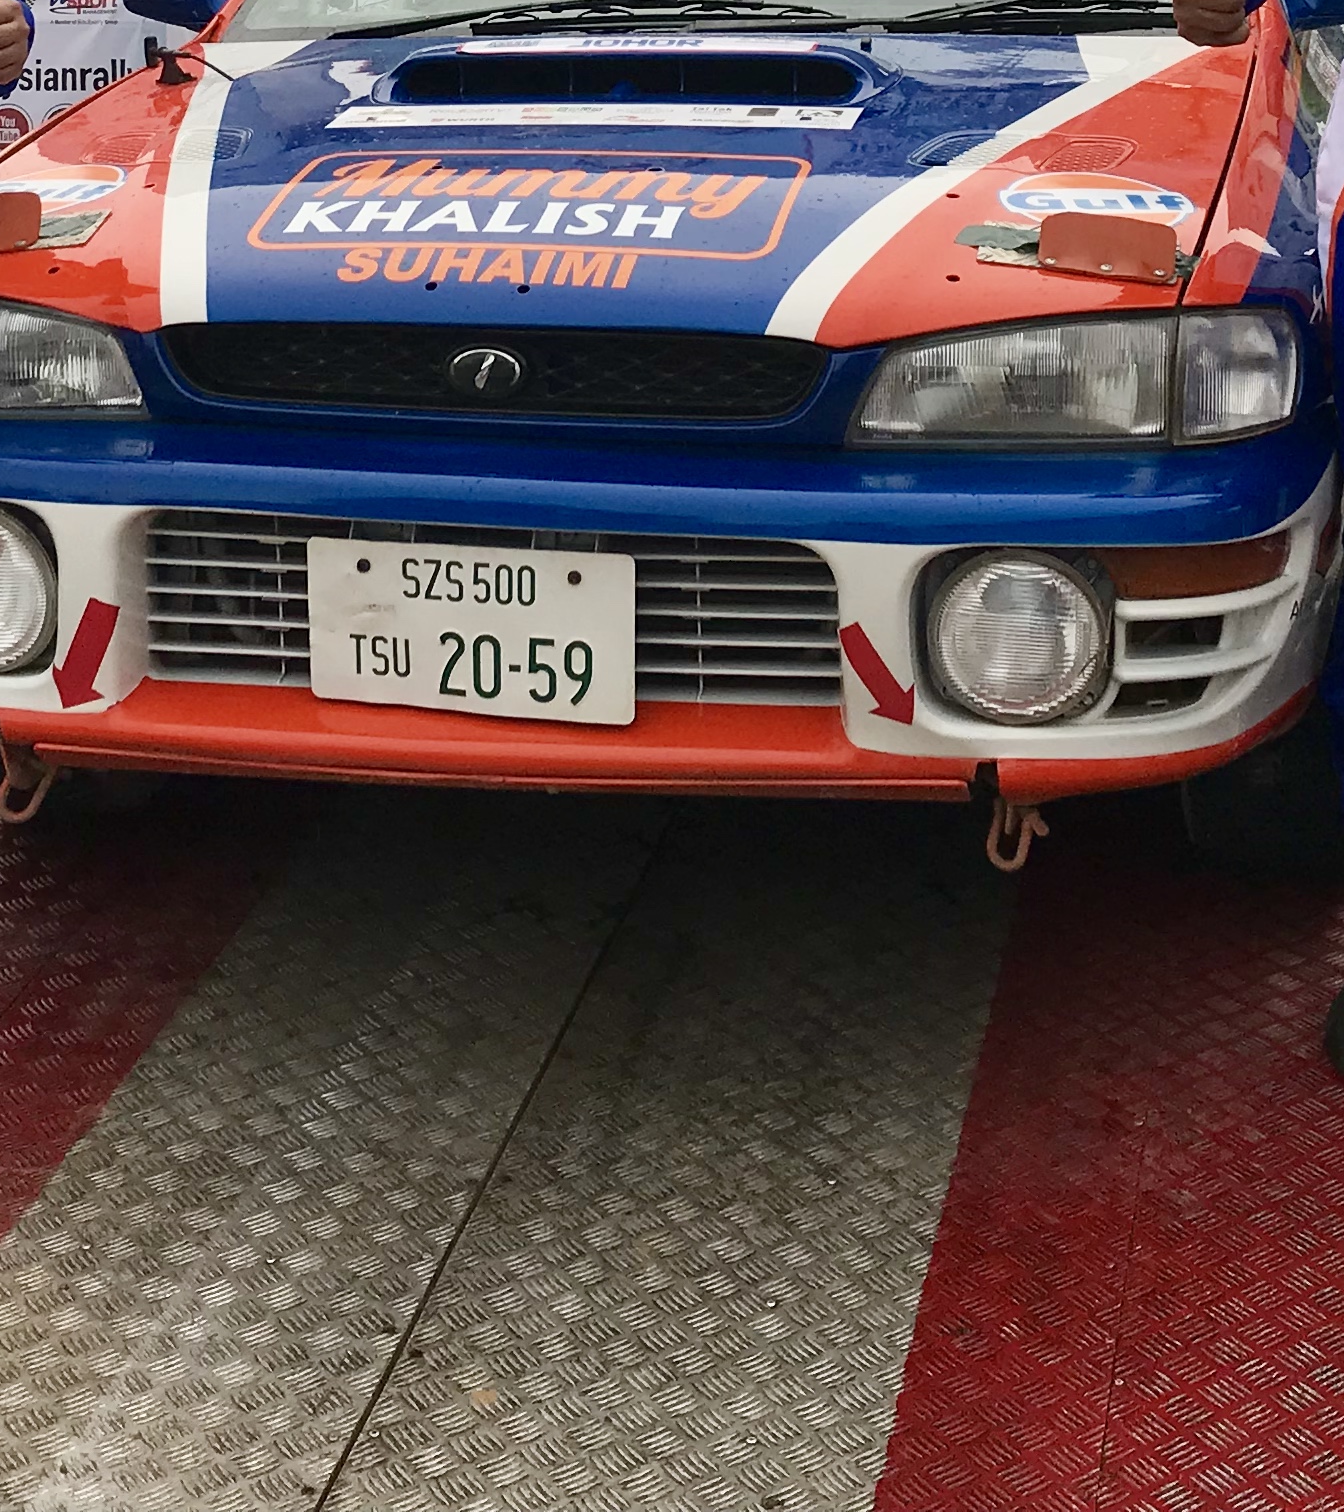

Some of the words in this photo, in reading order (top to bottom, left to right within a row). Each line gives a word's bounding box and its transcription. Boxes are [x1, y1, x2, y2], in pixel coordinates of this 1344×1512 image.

[569, 39, 704, 48] JOHOR
[0, 116, 15, 127] You
[314, 159, 766, 219] Mummy
[1006, 192, 1185, 210] Gulf
[283, 200, 684, 239] KHALISH
[337, 248, 638, 289] SUHAIMI
[401, 558, 464, 602] SZS
[473, 563, 536, 606] 500
[350, 634, 410, 677] TSU
[439, 632, 592, 706] 20-59
